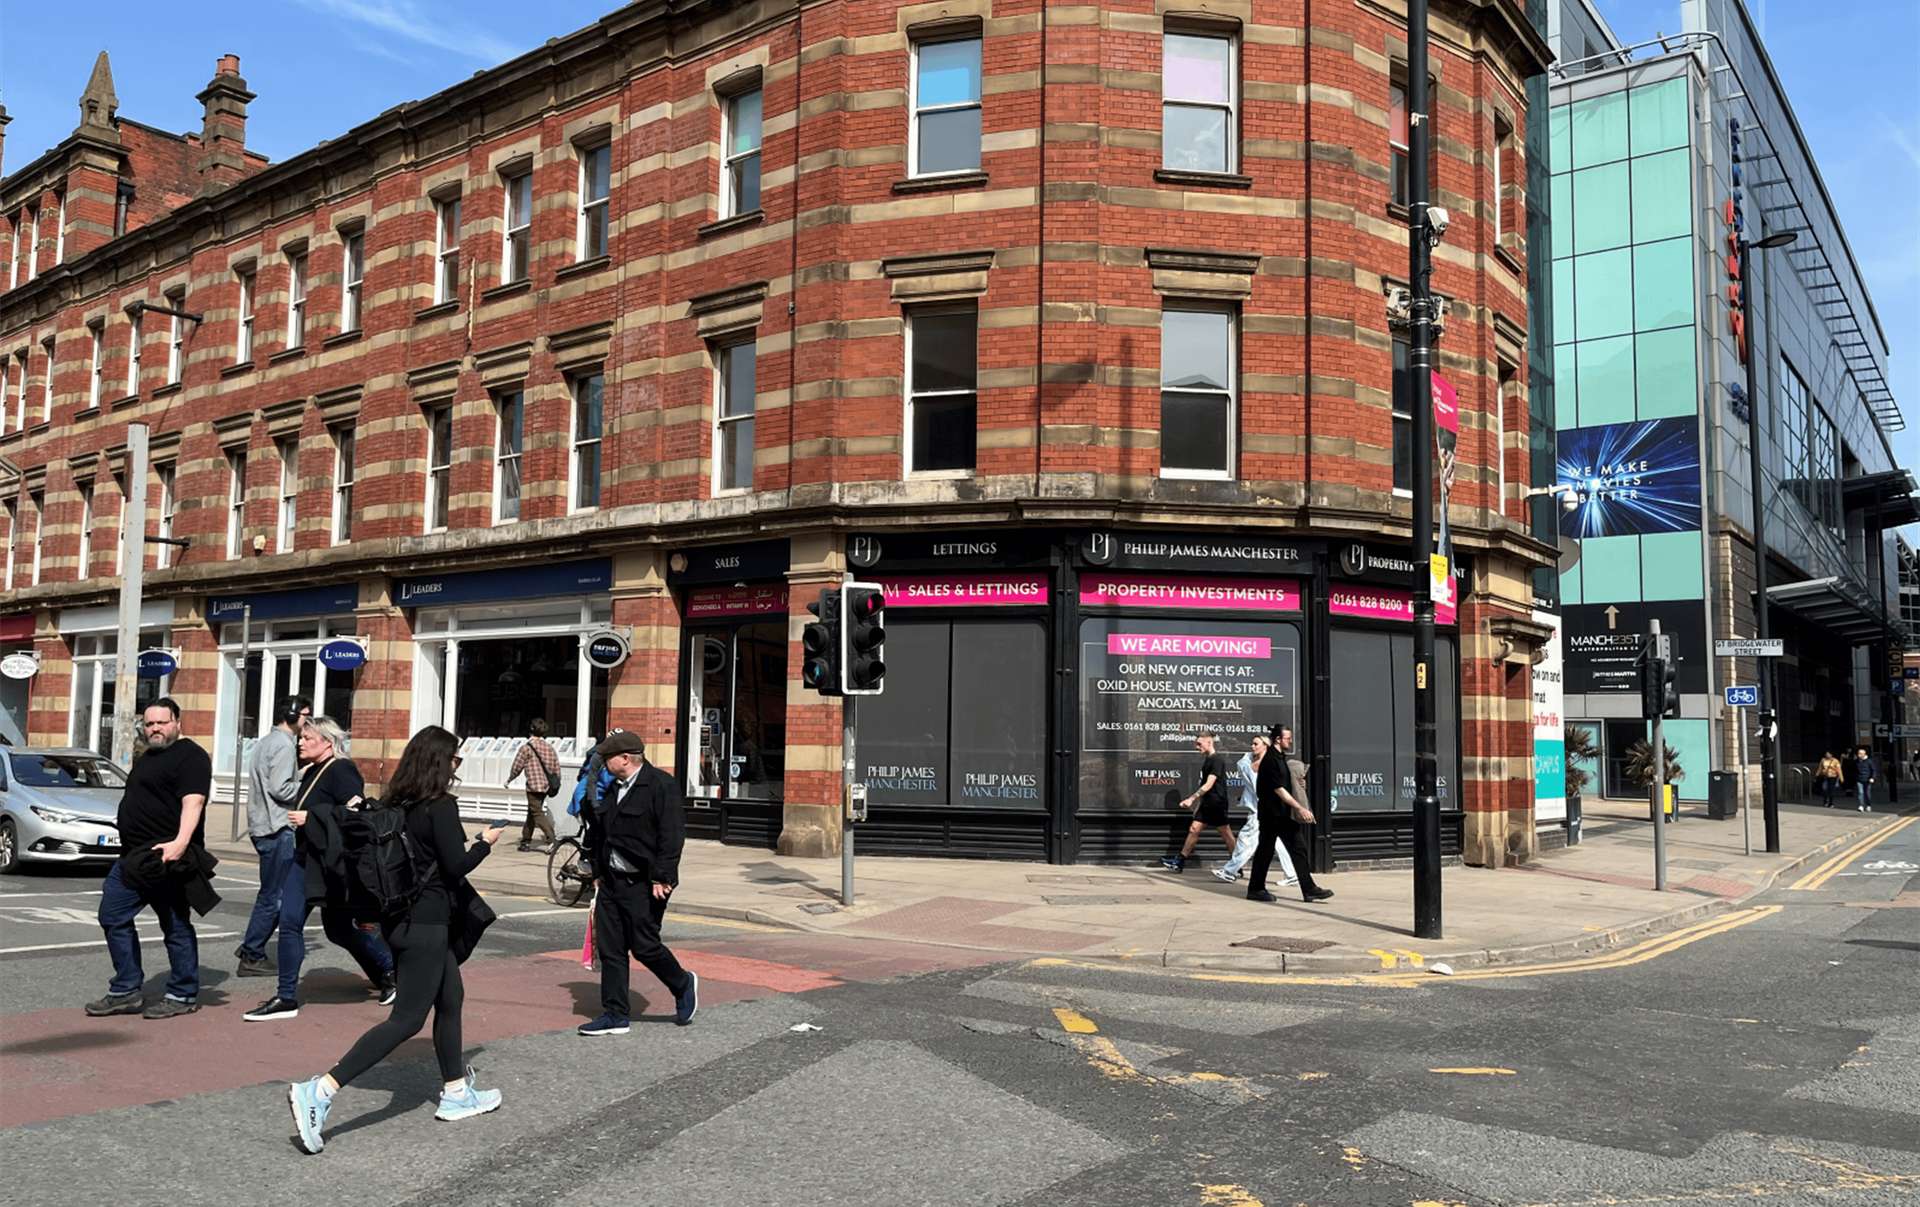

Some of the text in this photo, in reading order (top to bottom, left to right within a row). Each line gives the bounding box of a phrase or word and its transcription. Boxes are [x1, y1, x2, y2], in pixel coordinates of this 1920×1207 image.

[1601, 461, 1648, 475] MAKE
[1579, 490, 1638, 503] BETTER
[933, 542, 997, 556] LETTINGS
[1124, 542, 1299, 560] PHILIP JAMES MANCHESTER
[715, 556, 740, 569] SALES
[1368, 555, 1409, 572] PROPERTY
[413, 582, 442, 594] LEADERS
[908, 583, 950, 597] SALES
[954, 584, 963, 596] &
[968, 583, 1039, 596] LETTINGS
[1098, 583, 1285, 601] PROPERTY INVESTMENTS
[1333, 592, 1403, 611] 0161 828 8200
[1120, 638, 1257, 654] WE ARE MOVING!
[1728, 640, 1782, 648] BRIDGEWATER
[1735, 648, 1762, 656] STREET
[1119, 663, 1255, 677] OUR NEW OFFICE IS AT:
[1097, 680, 1127, 691] OXID
[1178, 682, 1232, 693] NEWTON
[1234, 683, 1279, 695] STREET,
[1200, 698, 1217, 709] M1
[1221, 699, 1242, 710] 1AL
[1123, 723, 1143, 731] 0161
[1226, 724, 1246, 733] 0161
[867, 765, 935, 780] PHILIP JAMES
[864, 777, 937, 791] MANCHESTER
[965, 773, 1036, 788] PHILIP JAMES
[961, 786, 1039, 800] MANCHESTER
[309, 1106, 317, 1128] HOKA
